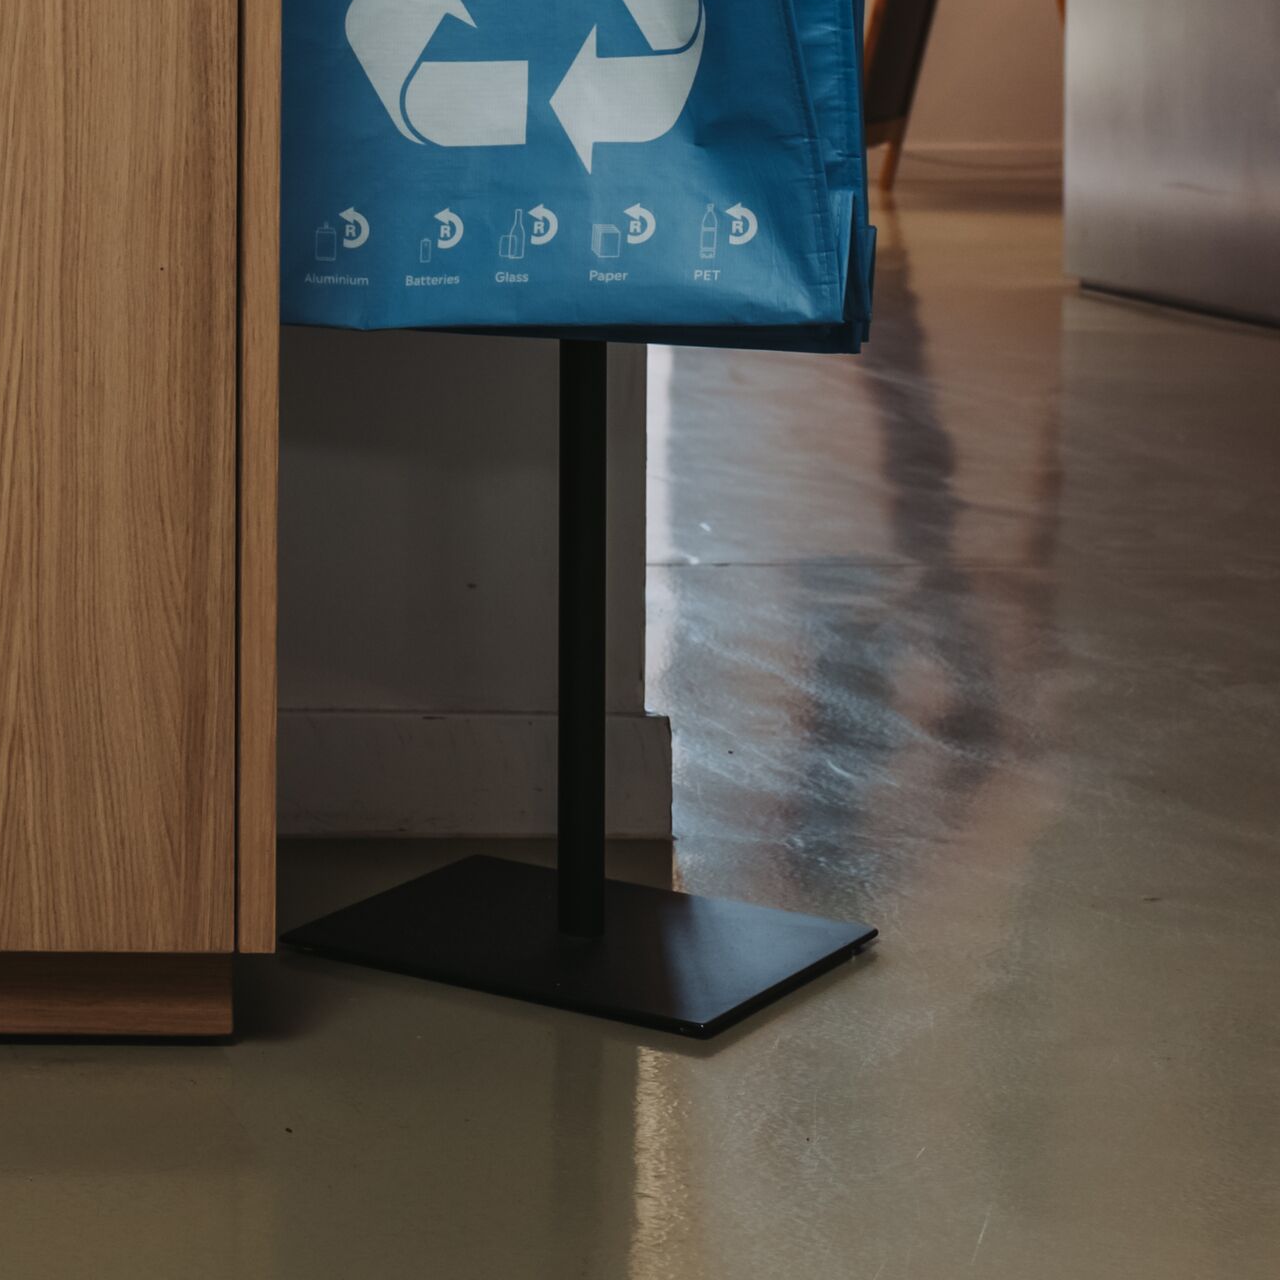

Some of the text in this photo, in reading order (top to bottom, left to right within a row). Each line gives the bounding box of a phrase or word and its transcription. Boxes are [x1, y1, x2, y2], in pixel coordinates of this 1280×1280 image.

[345, 224, 357, 238] R
[439, 224, 451, 238] R
[533, 221, 545, 234] R
[629, 220, 642, 234] R
[731, 220, 744, 234] R
[304, 273, 369, 286] Aluminium
[405, 274, 460, 287] Batteries
[495, 271, 529, 283] Glass
[589, 270, 628, 283] Paper
[693, 270, 721, 281] PET
